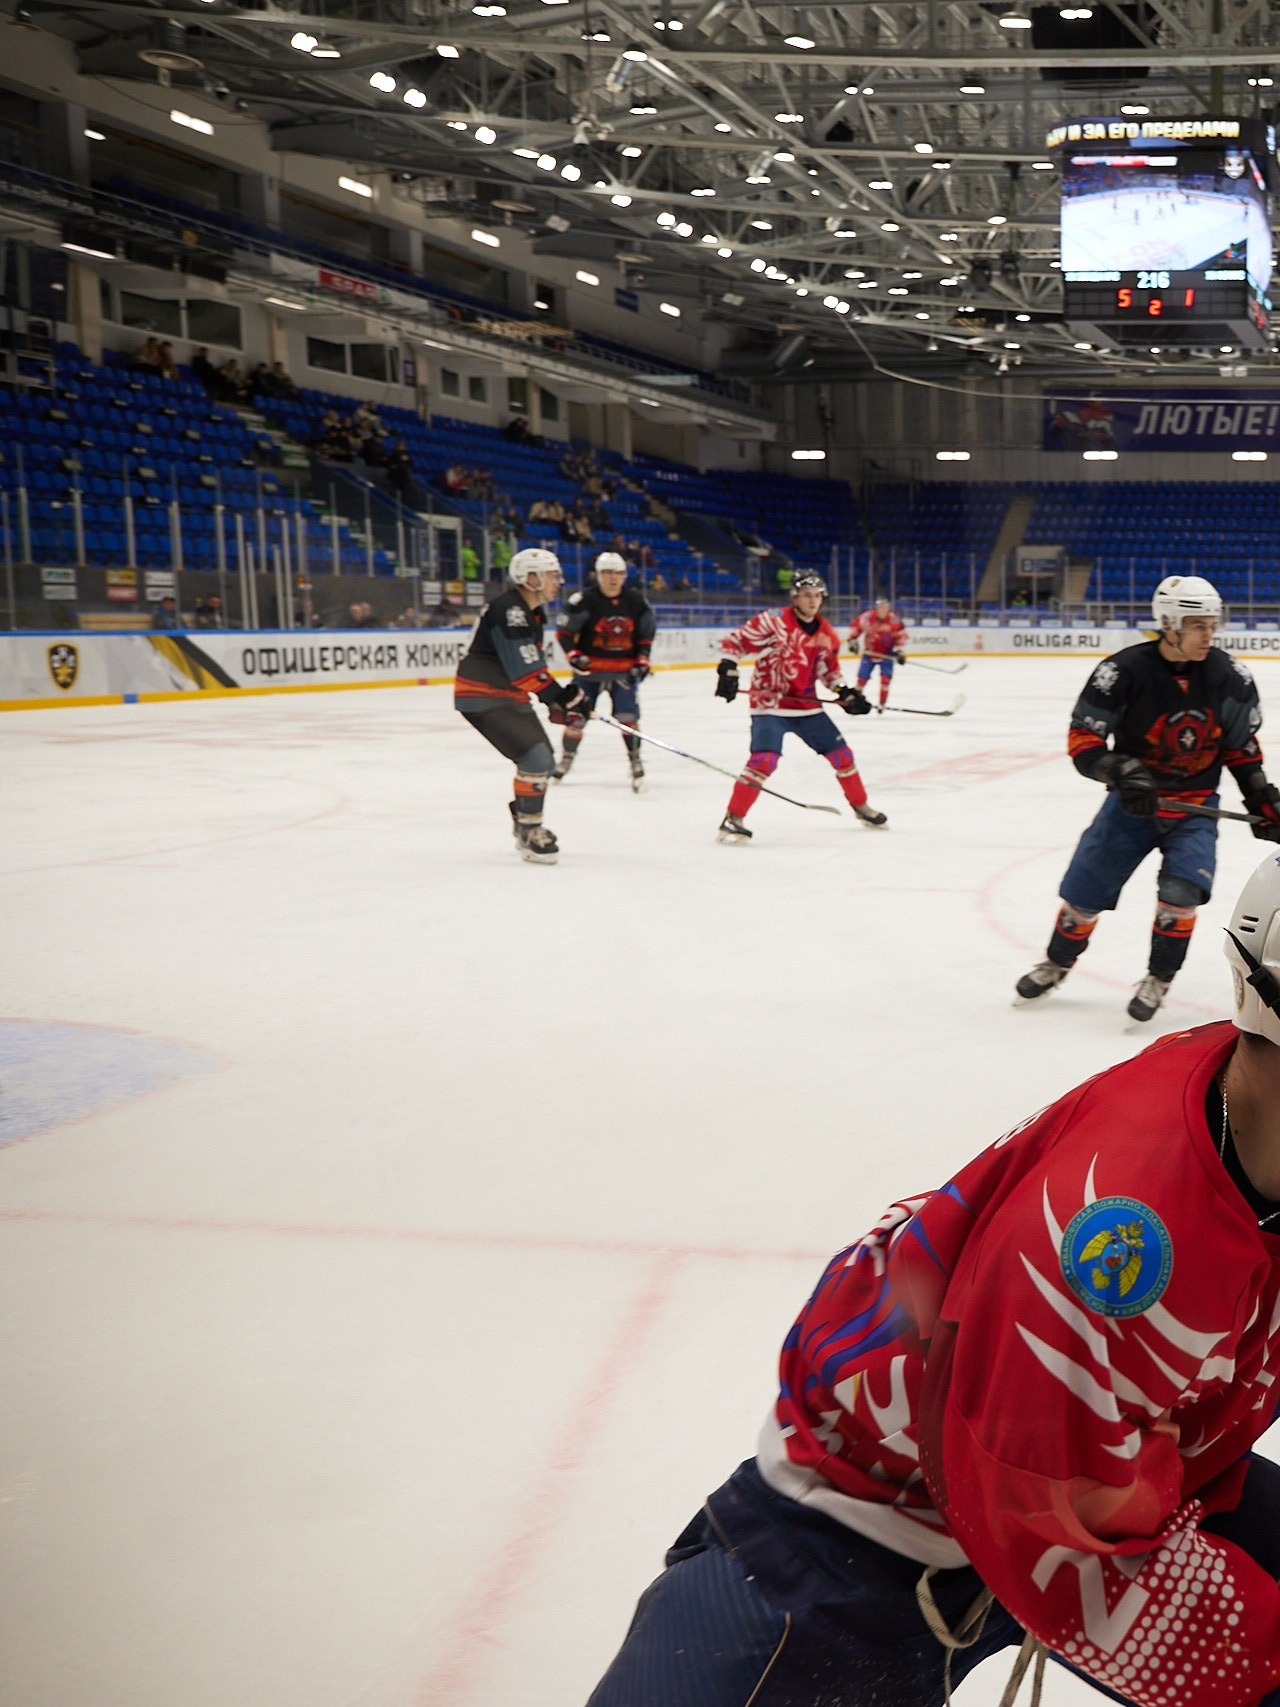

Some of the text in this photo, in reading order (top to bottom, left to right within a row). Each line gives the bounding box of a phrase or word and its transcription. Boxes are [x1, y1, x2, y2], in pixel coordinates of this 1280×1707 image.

[1083, 123, 1106, 140] ЗА
[1108, 122, 1139, 139] ЕГО
[1141, 121, 1240, 140] ПРЕДЕЛАМИ
[1117, 288, 1132, 308] 5
[1133, 405, 1279, 436] ЛЮТЫЕ!
[1013, 633, 1100, 648] OHLIGA.RU
[243, 643, 467, 677] ОФИЦЕРСКАЯ ХОККЕ
